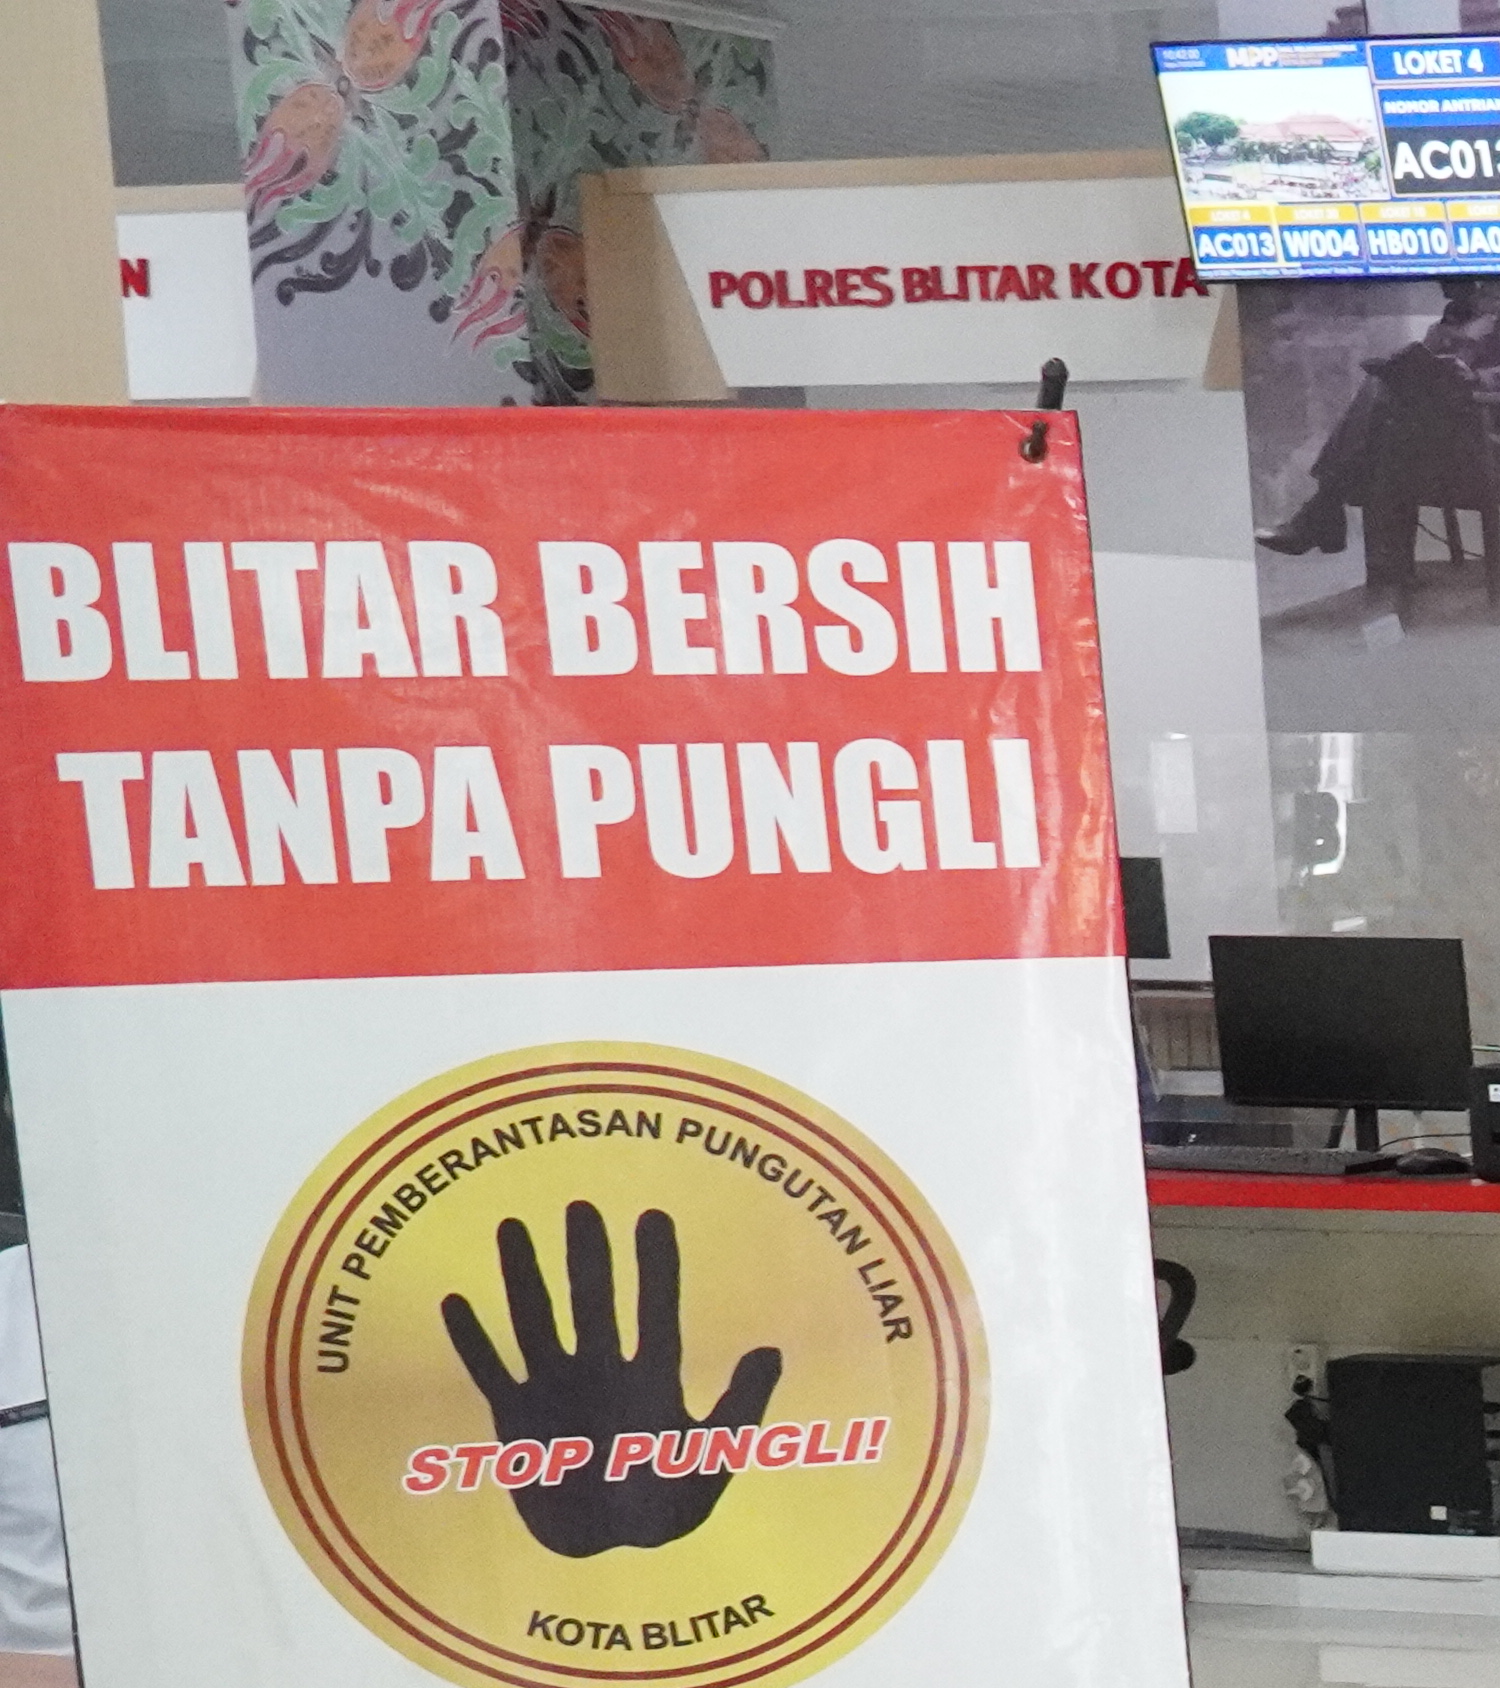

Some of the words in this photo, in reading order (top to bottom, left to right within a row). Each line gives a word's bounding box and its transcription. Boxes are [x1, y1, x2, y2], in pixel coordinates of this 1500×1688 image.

[1394, 50, 1463, 76] LOKET
[1468, 49, 1484, 73] 4
[1198, 230, 1276, 258] AC013
[1284, 228, 1360, 257] W004
[1369, 226, 1449, 256] HB010
[710, 266, 893, 307] POLRES
[901, 264, 1054, 302] BLITAR
[1070, 257, 1210, 302] KOTA
[7, 540, 509, 682] BLITAR
[537, 538, 1043, 677] BERSIH
[55, 745, 526, 890] TANPA
[549, 737, 1043, 879] PUNGLI
[317, 1284, 363, 1375] UNIT
[343, 1108, 663, 1280] PEMBERANTASAN
[677, 1117, 871, 1258] PUNGUTAN
[857, 1257, 914, 1344] LIAR
[403, 1435, 592, 1495] STOP
[605, 1417, 891, 1483] PUNGLI!
[526, 1610, 633, 1652] KOTA
[641, 1594, 775, 1651] BLITAR
